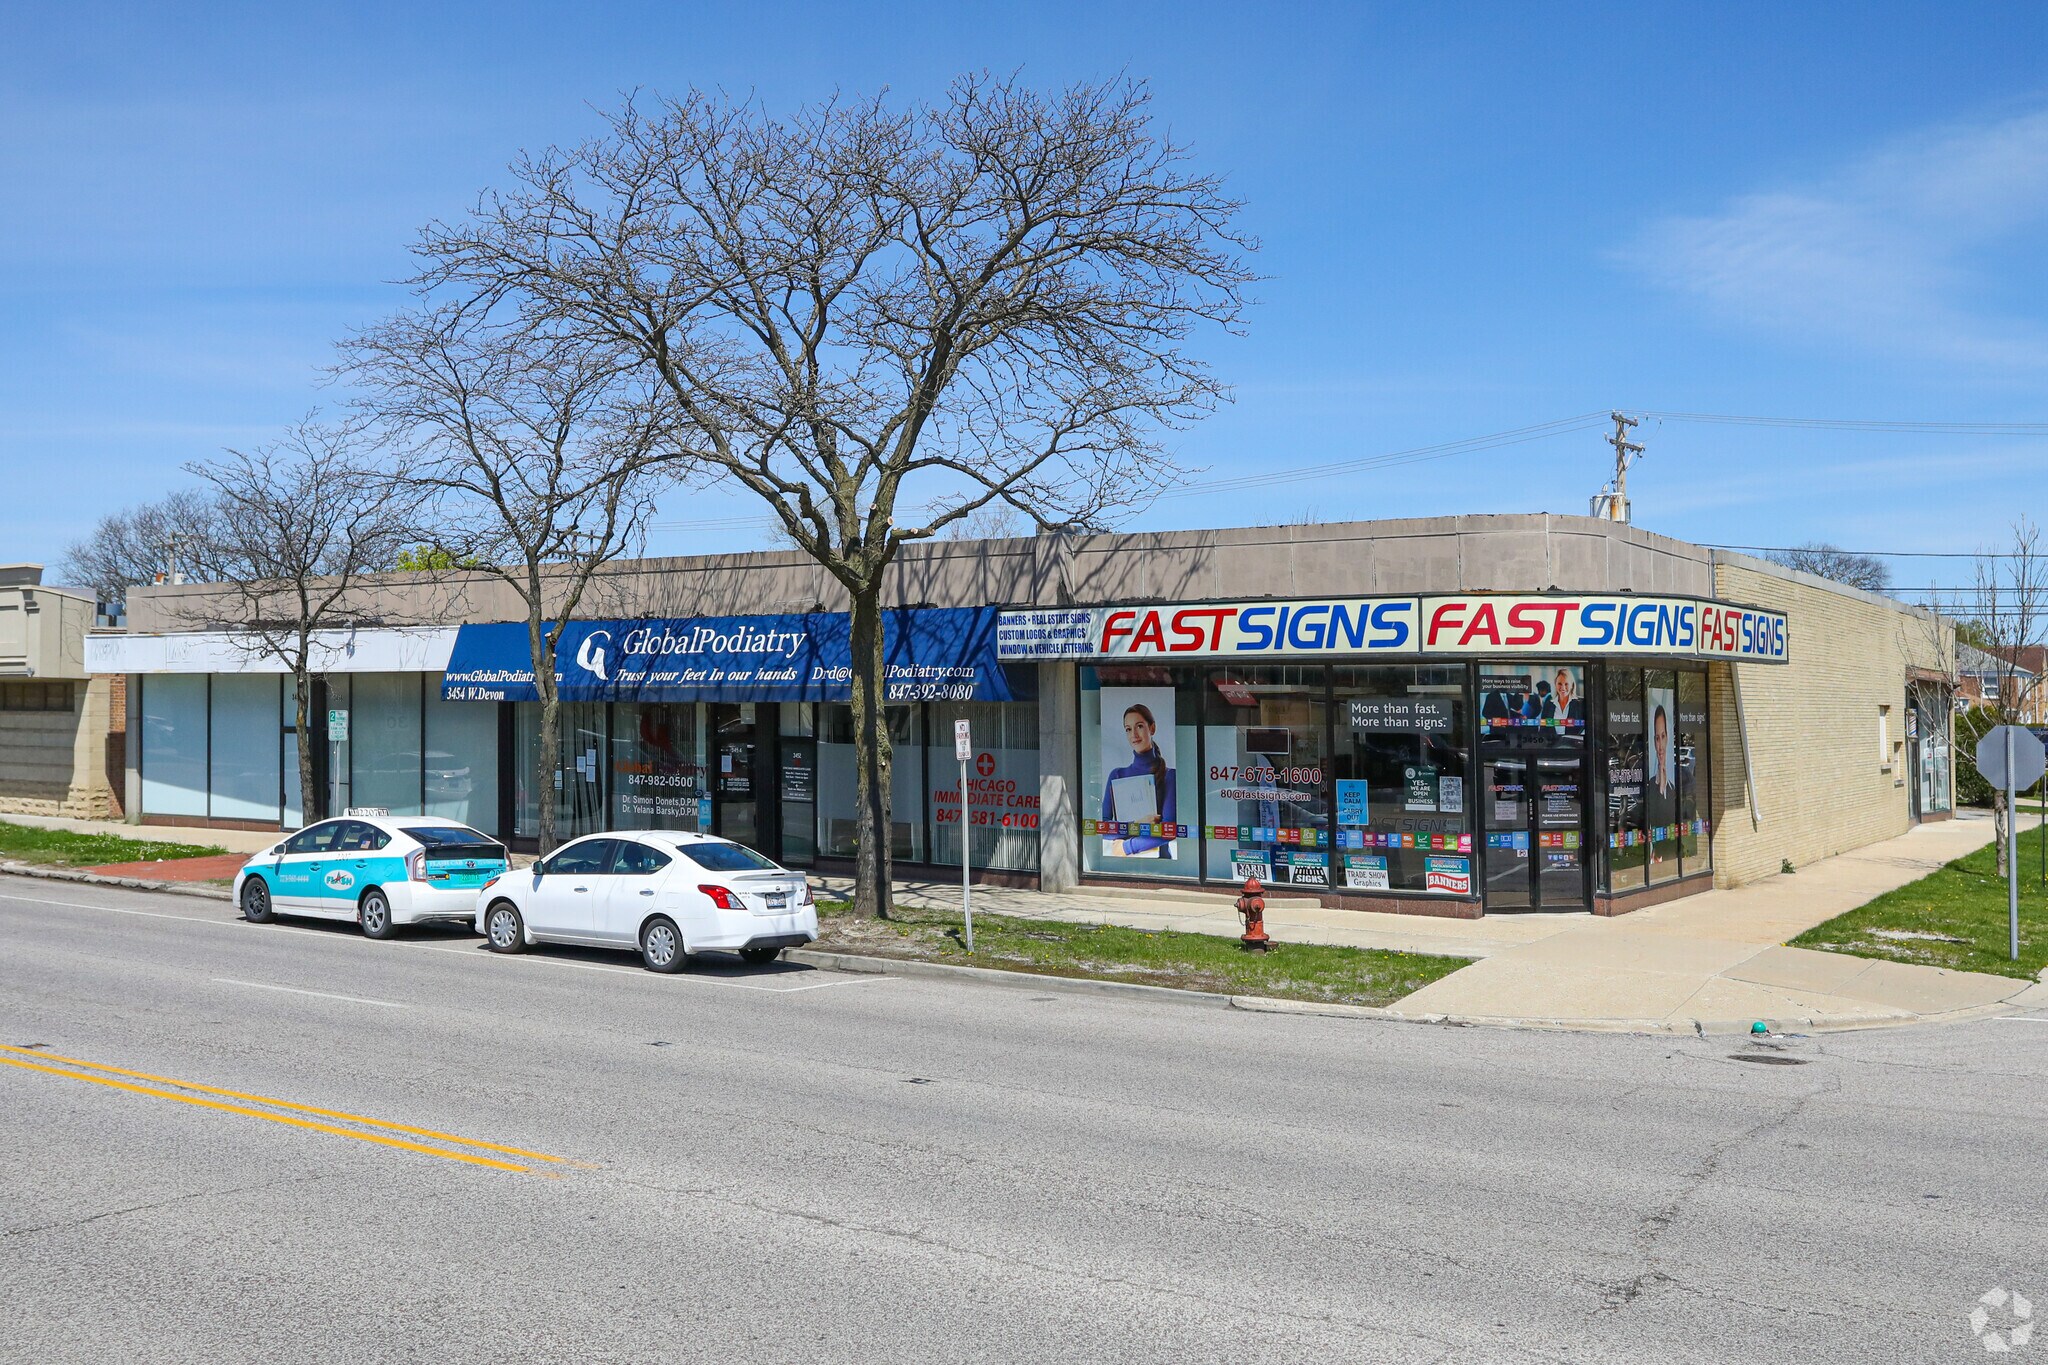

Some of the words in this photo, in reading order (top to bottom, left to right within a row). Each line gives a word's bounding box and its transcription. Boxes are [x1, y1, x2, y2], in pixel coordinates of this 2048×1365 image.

[998, 614, 1026, 626] BANNERS
[1032, 614, 1047, 625] REAL
[1048, 614, 1070, 624] ESTATE
[1070, 612, 1090, 624] SIGNS
[1427, 603, 1694, 646] FASTSIGNS
[1101, 602, 1412, 652] FASTSIGNS
[1700, 607, 1784, 656] FASTSIGNS
[999, 629, 1026, 640] CUSTOM
[1026, 630, 1046, 640] LOGOS
[1047, 630, 1052, 639] &
[1054, 628, 1086, 639] GRAPHICS
[624, 626, 807, 658] GlobalPodiatry
[1000, 644, 1028, 654] WINDOW
[1028, 645, 1034, 654] &
[1034, 643, 1060, 654] VEHICLE
[1061, 642, 1094, 653] LETTERING
[614, 668, 646, 682] Trust
[647, 670, 678, 684] your
[678, 668, 706, 684] feet
[708, 668, 724, 680] In
[727, 670, 752, 681] our
[754, 667, 798, 680] hands
[446, 687, 465, 700] 3454
[468, 687, 504, 700] W.Devon
[889, 684, 974, 700] 847-392-8080
[1351, 703, 1379, 714] More
[1383, 703, 1408, 714] than
[1414, 703, 1440, 714] fast.
[1351, 716, 1380, 726] More
[1384, 716, 1409, 727] than
[628, 775, 693, 788] 847-982-0500
[1210, 766, 1322, 784] 847-675-1600
[622, 795, 631, 803] Dr.
[633, 795, 654, 805] Simon
[934, 791, 1004, 807] IMMDIATE
[1006, 795, 1040, 808] CARE
[1220, 789, 1312, 802] 80@fastsigns.com
[1239, 870, 1265, 879] SIGNS
[1240, 864, 1264, 872] YARD
[1347, 870, 1367, 878] TRADE
[1369, 871, 1386, 879] SHOW
[1296, 875, 1324, 884] SIGNS
[1354, 878, 1382, 888] Graphics
[1429, 876, 1467, 890] BANNERS
